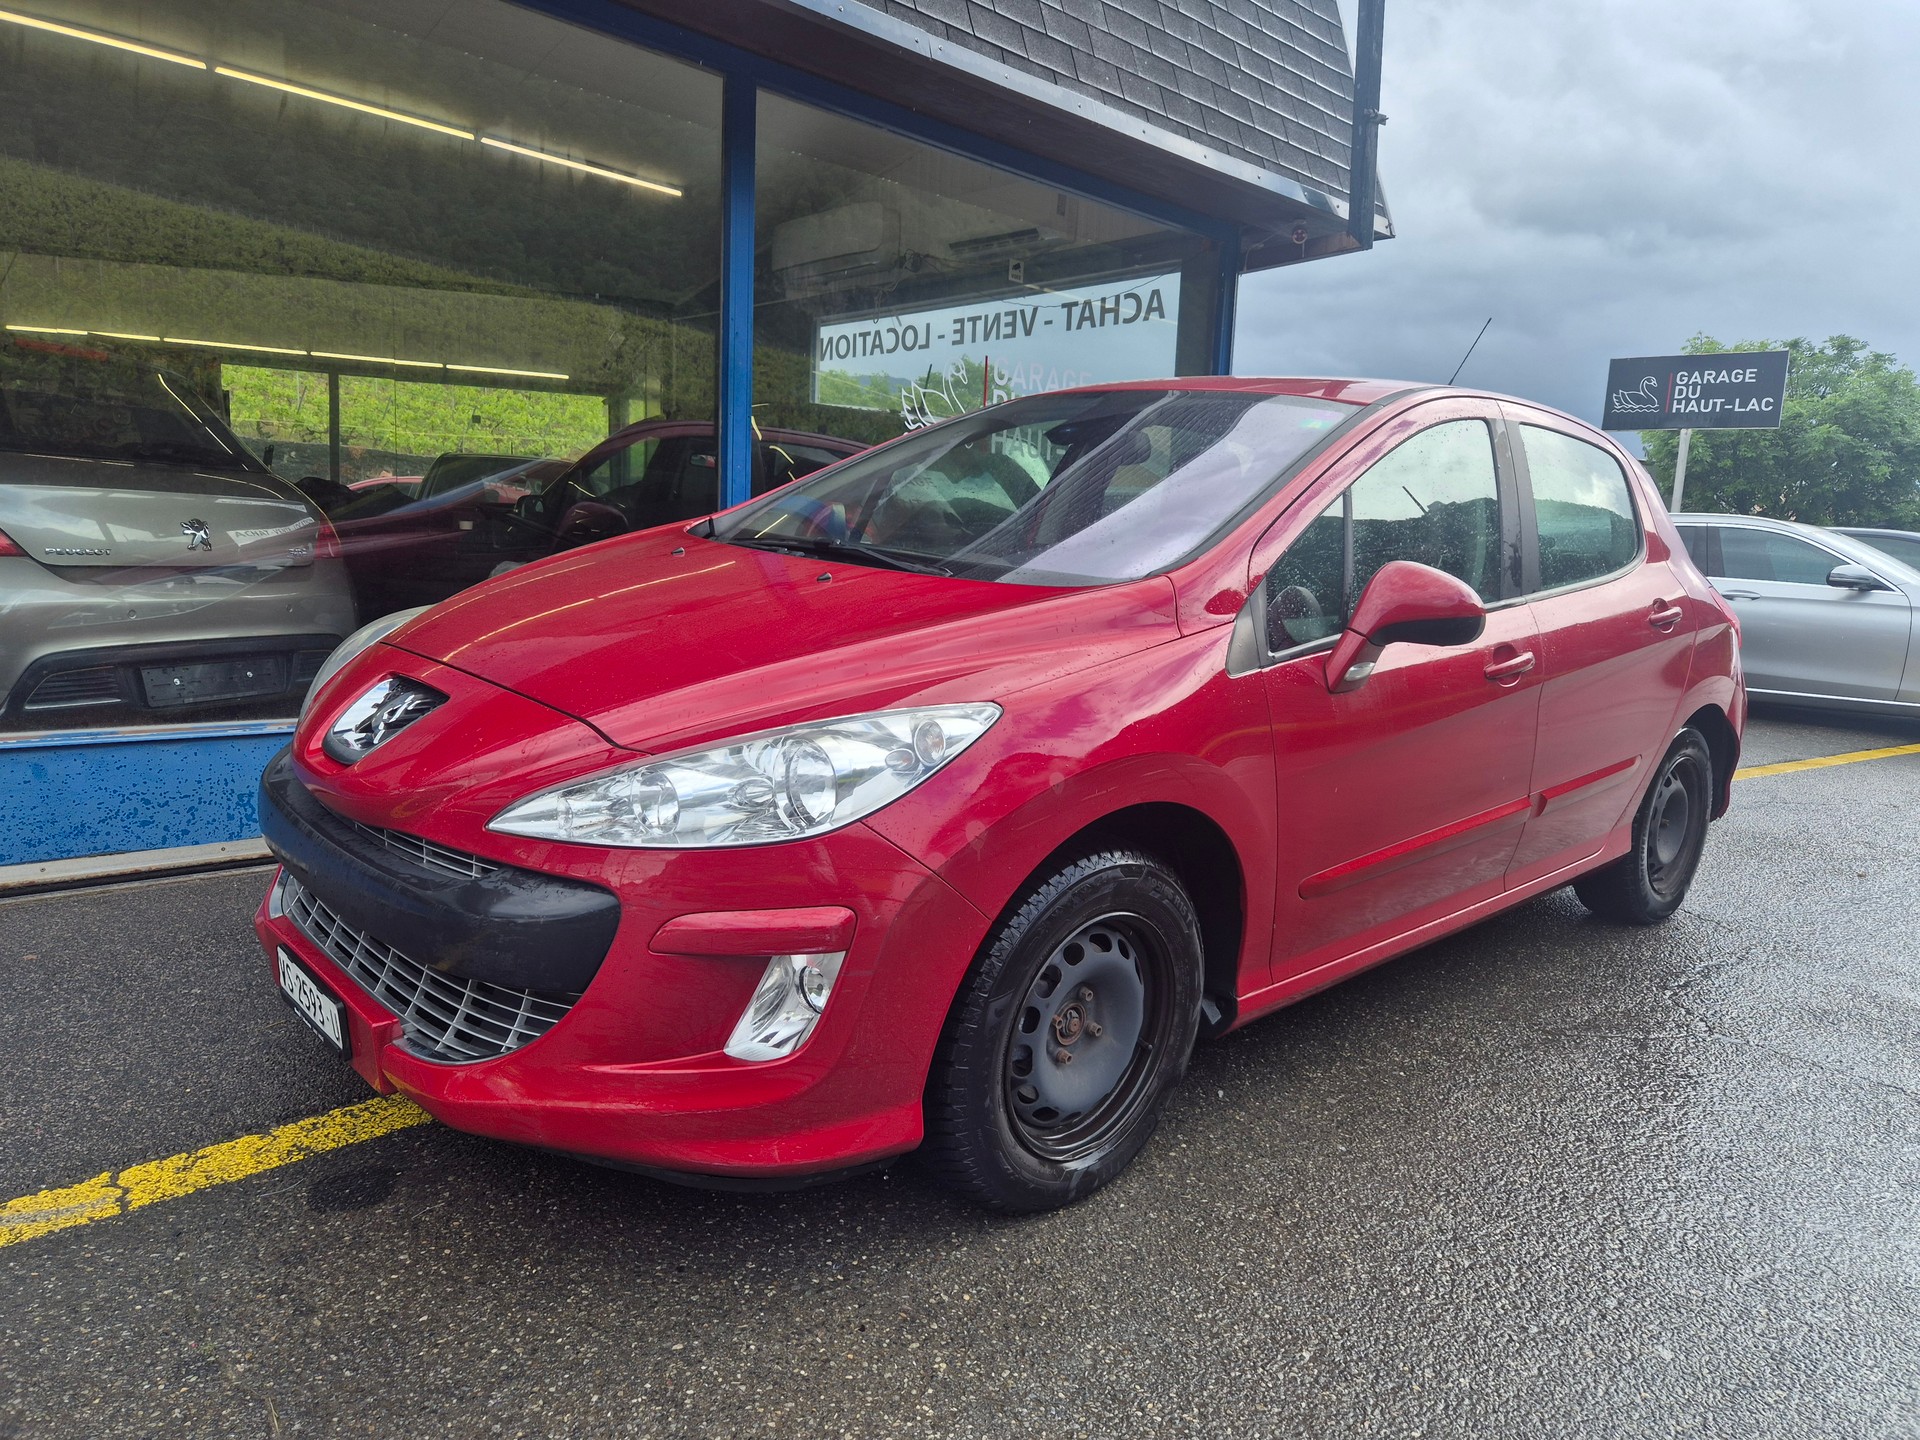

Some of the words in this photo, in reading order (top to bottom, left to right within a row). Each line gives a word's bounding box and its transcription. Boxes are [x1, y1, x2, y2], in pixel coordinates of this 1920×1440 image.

[1676, 369, 1757, 385] GARAGE
[1674, 386, 1700, 399] DU
[1672, 397, 1774, 413] HAUT-LAC
[45, 547, 112, 556] PEUGEOT
